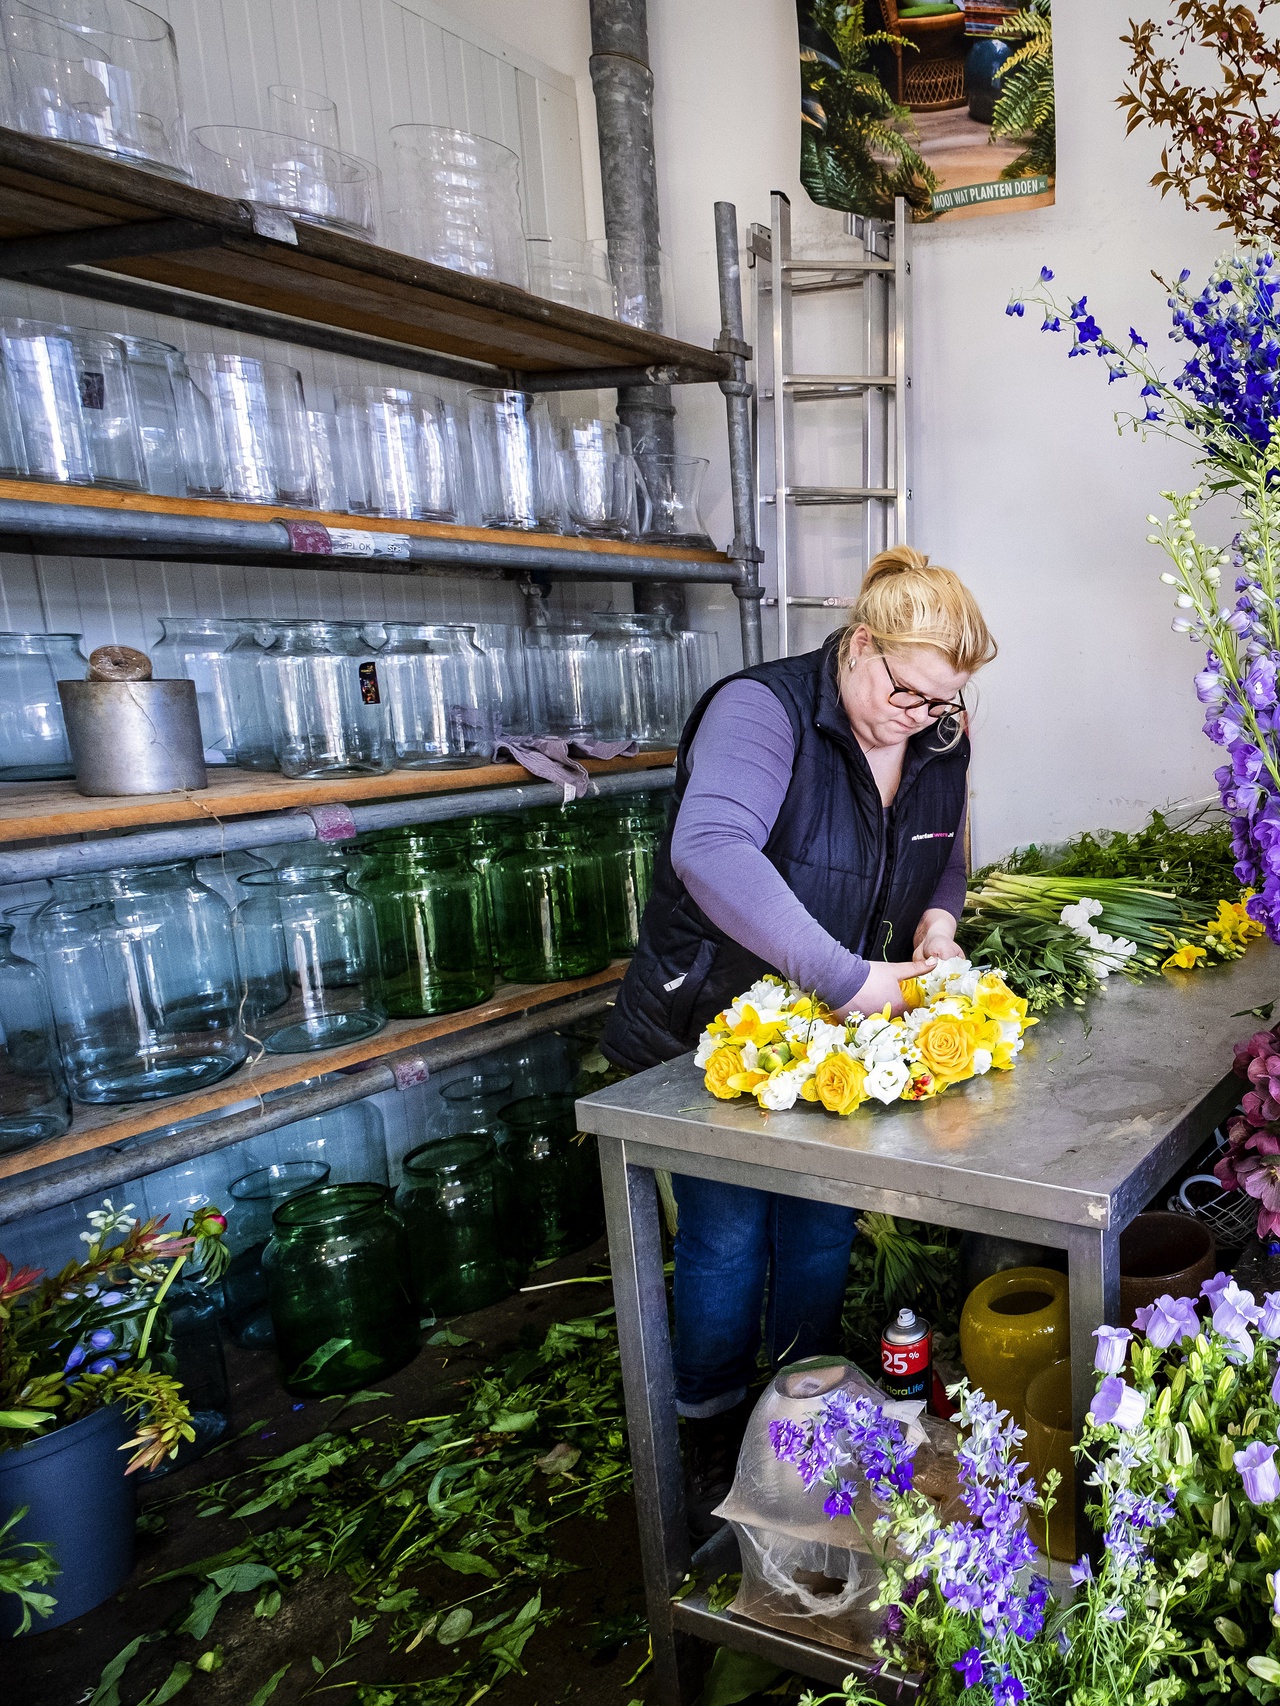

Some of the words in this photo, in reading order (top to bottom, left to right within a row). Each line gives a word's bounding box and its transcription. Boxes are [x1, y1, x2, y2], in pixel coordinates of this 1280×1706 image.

[932, 192, 954, 209] MOOI
[953, 189, 969, 205] WAT
[969, 182, 1013, 202] PLANTEN
[1014, 179, 1038, 195] DOEN
[886, 1383, 924, 1396] FloraLife
